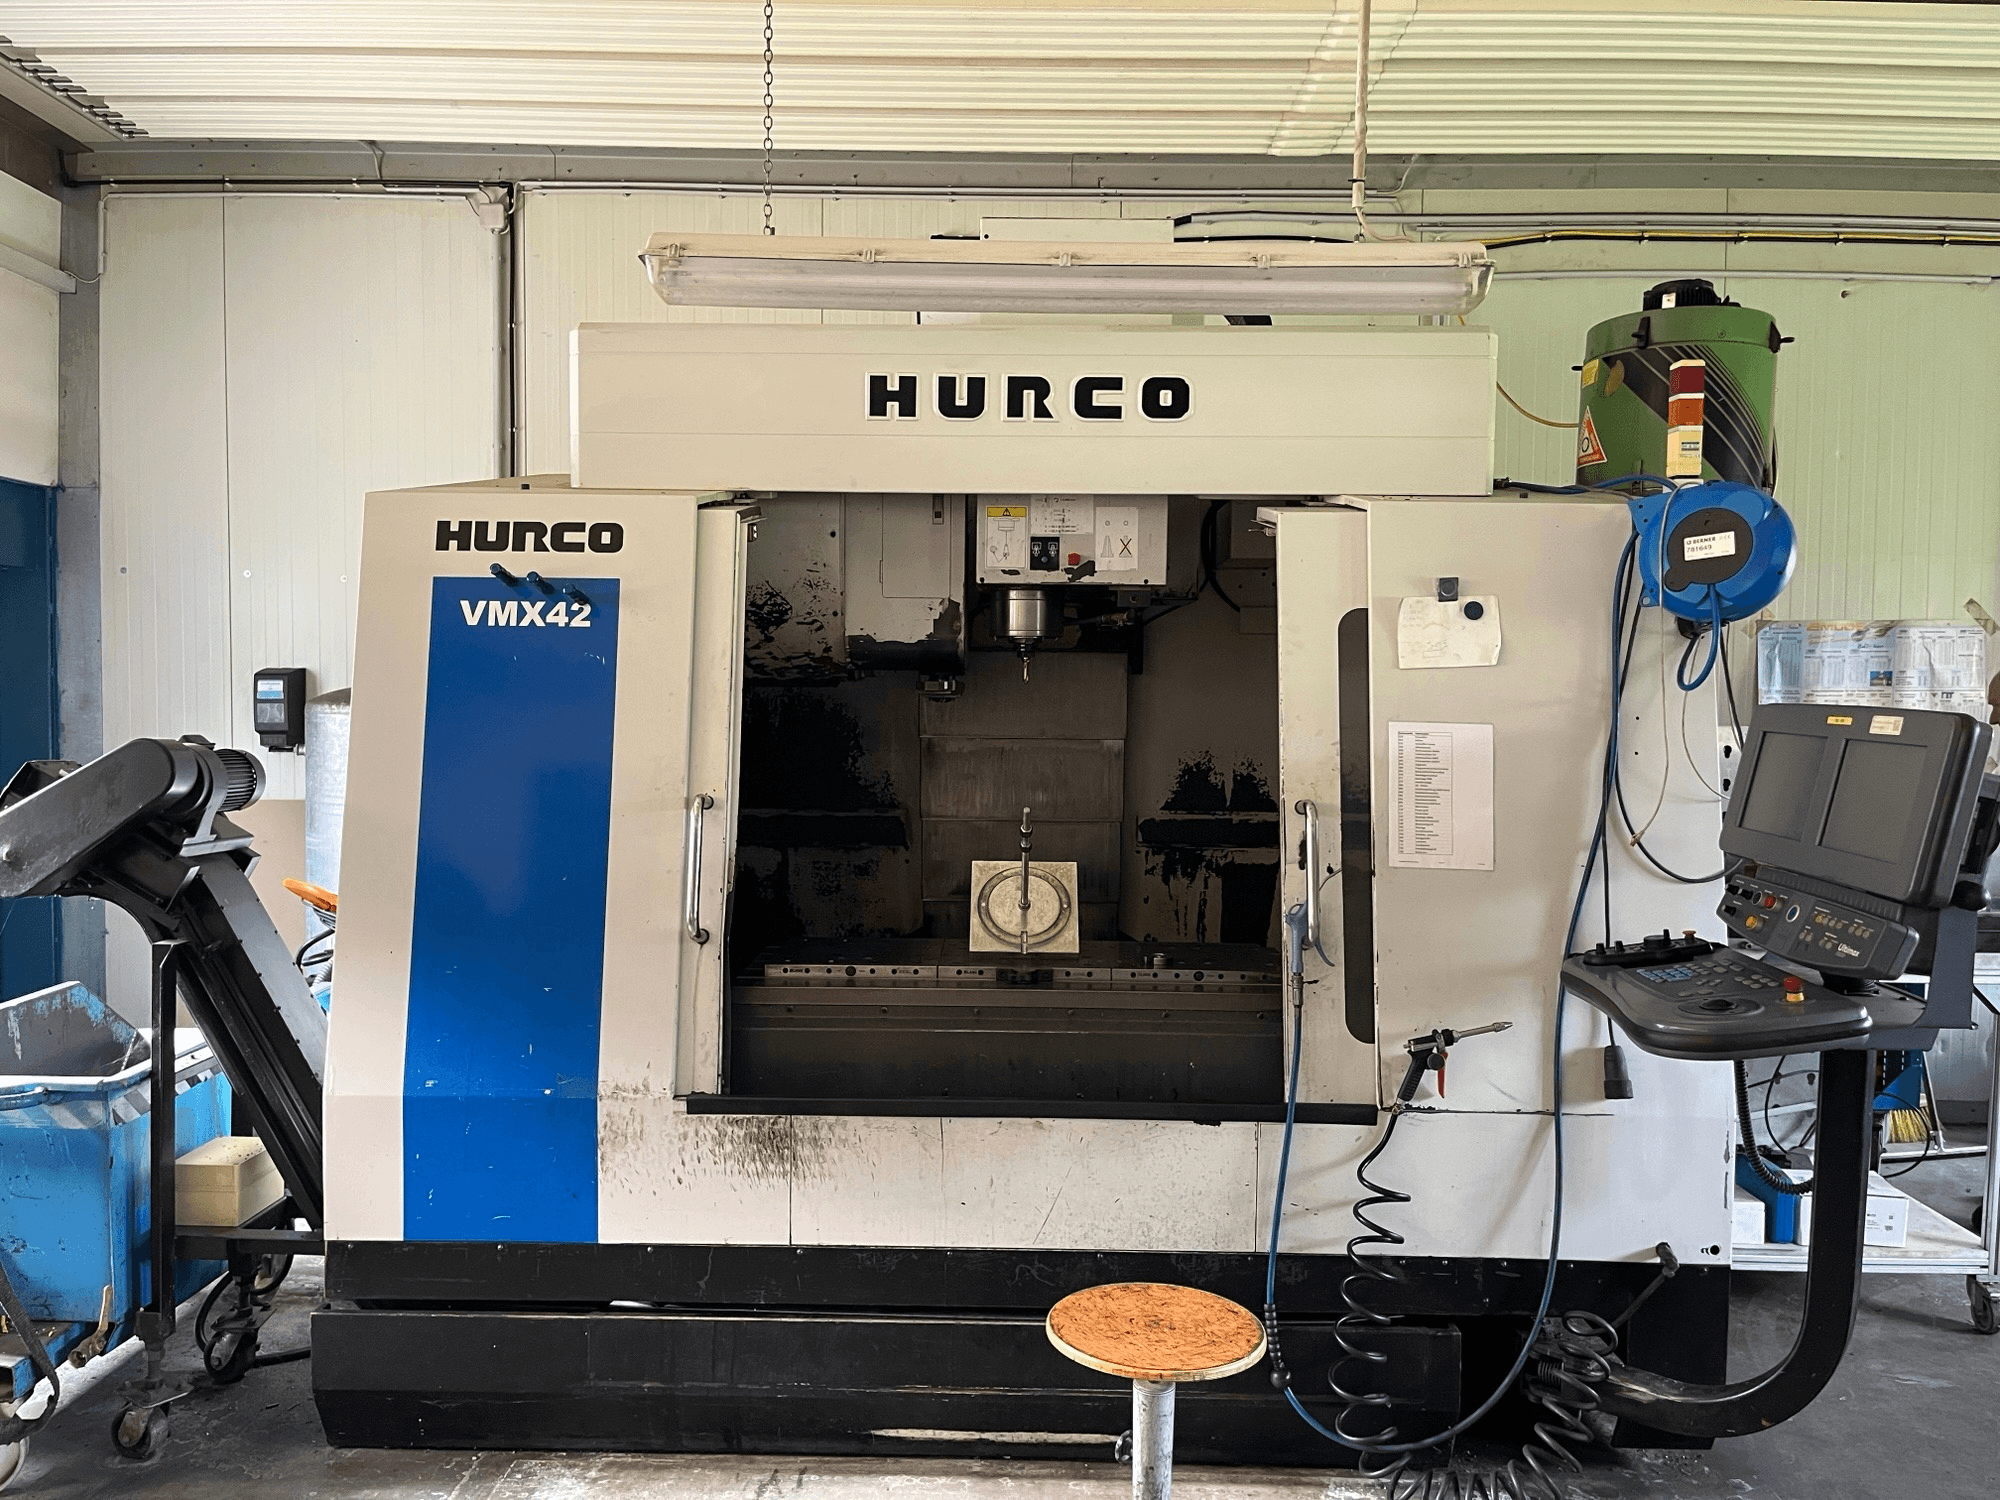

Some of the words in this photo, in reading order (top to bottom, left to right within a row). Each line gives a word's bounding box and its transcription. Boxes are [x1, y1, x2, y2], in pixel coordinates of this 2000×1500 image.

[867, 373, 1193, 421] HURCO
[435, 520, 624, 553] HURCO
[1692, 536, 1716, 545] BERNER
[459, 600, 592, 628] VMX42
